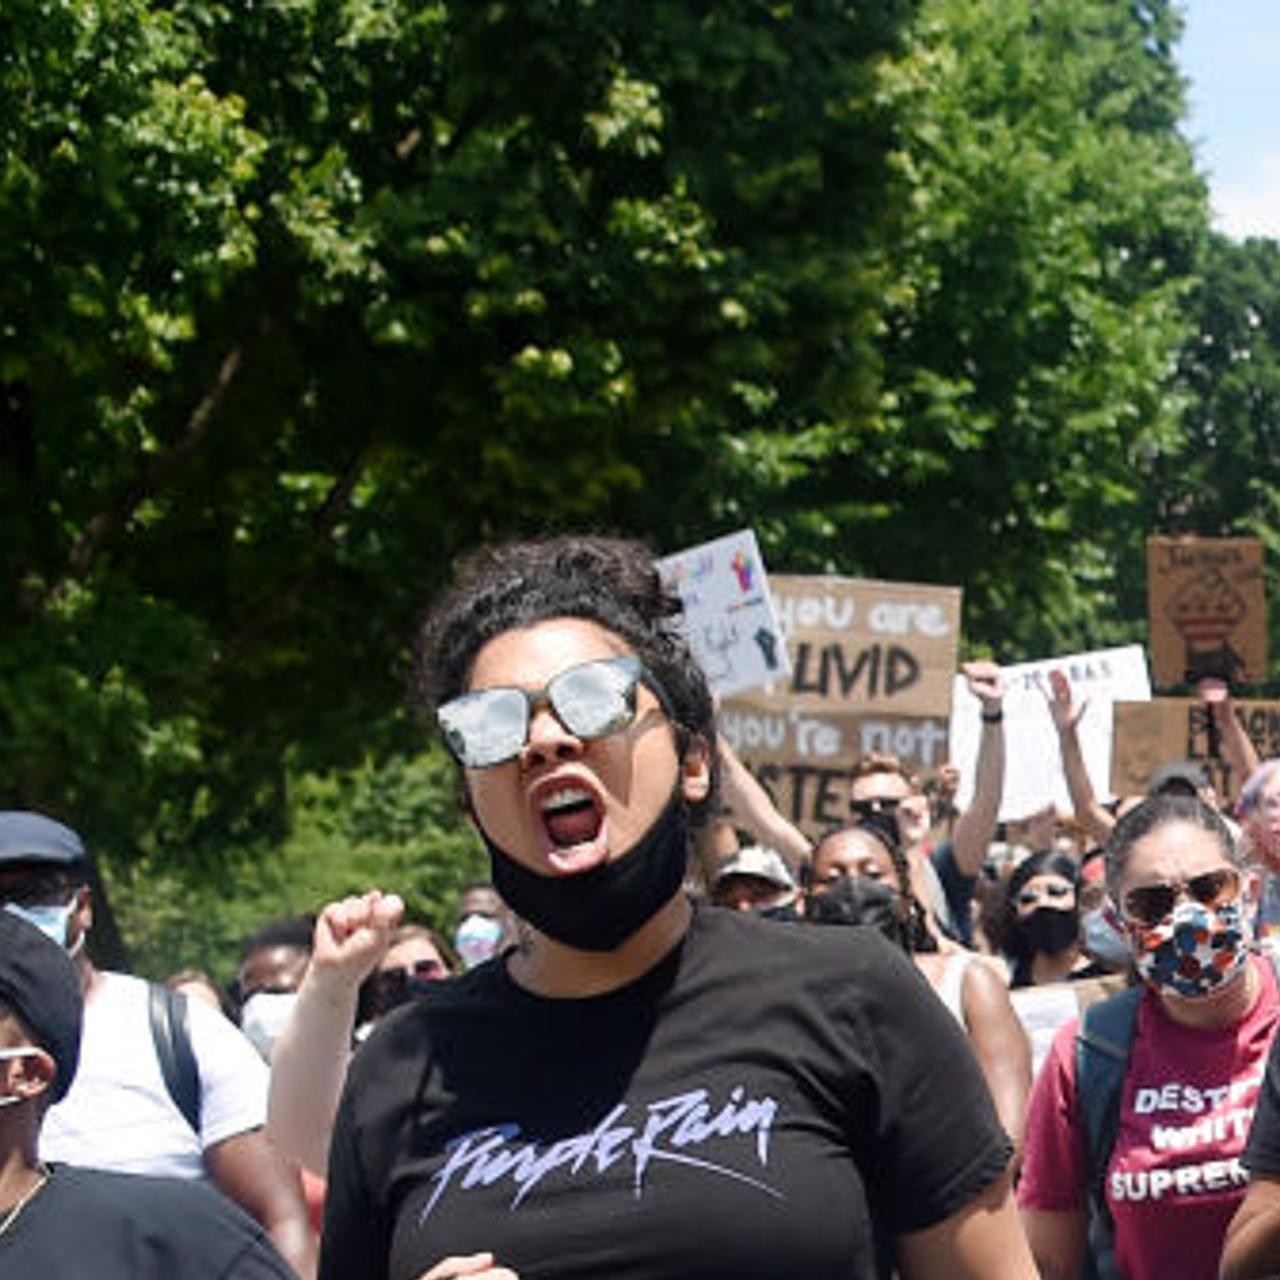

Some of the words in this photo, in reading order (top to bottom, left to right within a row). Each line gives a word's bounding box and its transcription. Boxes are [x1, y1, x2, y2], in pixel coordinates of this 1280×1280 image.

[868, 602, 949, 637] are
[792, 642, 920, 699] LIVID
[860, 719, 946, 768] not
[1152, 1107, 1254, 1150] WHIT
[418, 1104, 637, 1229] Purple
[632, 1085, 788, 1201] Rain
